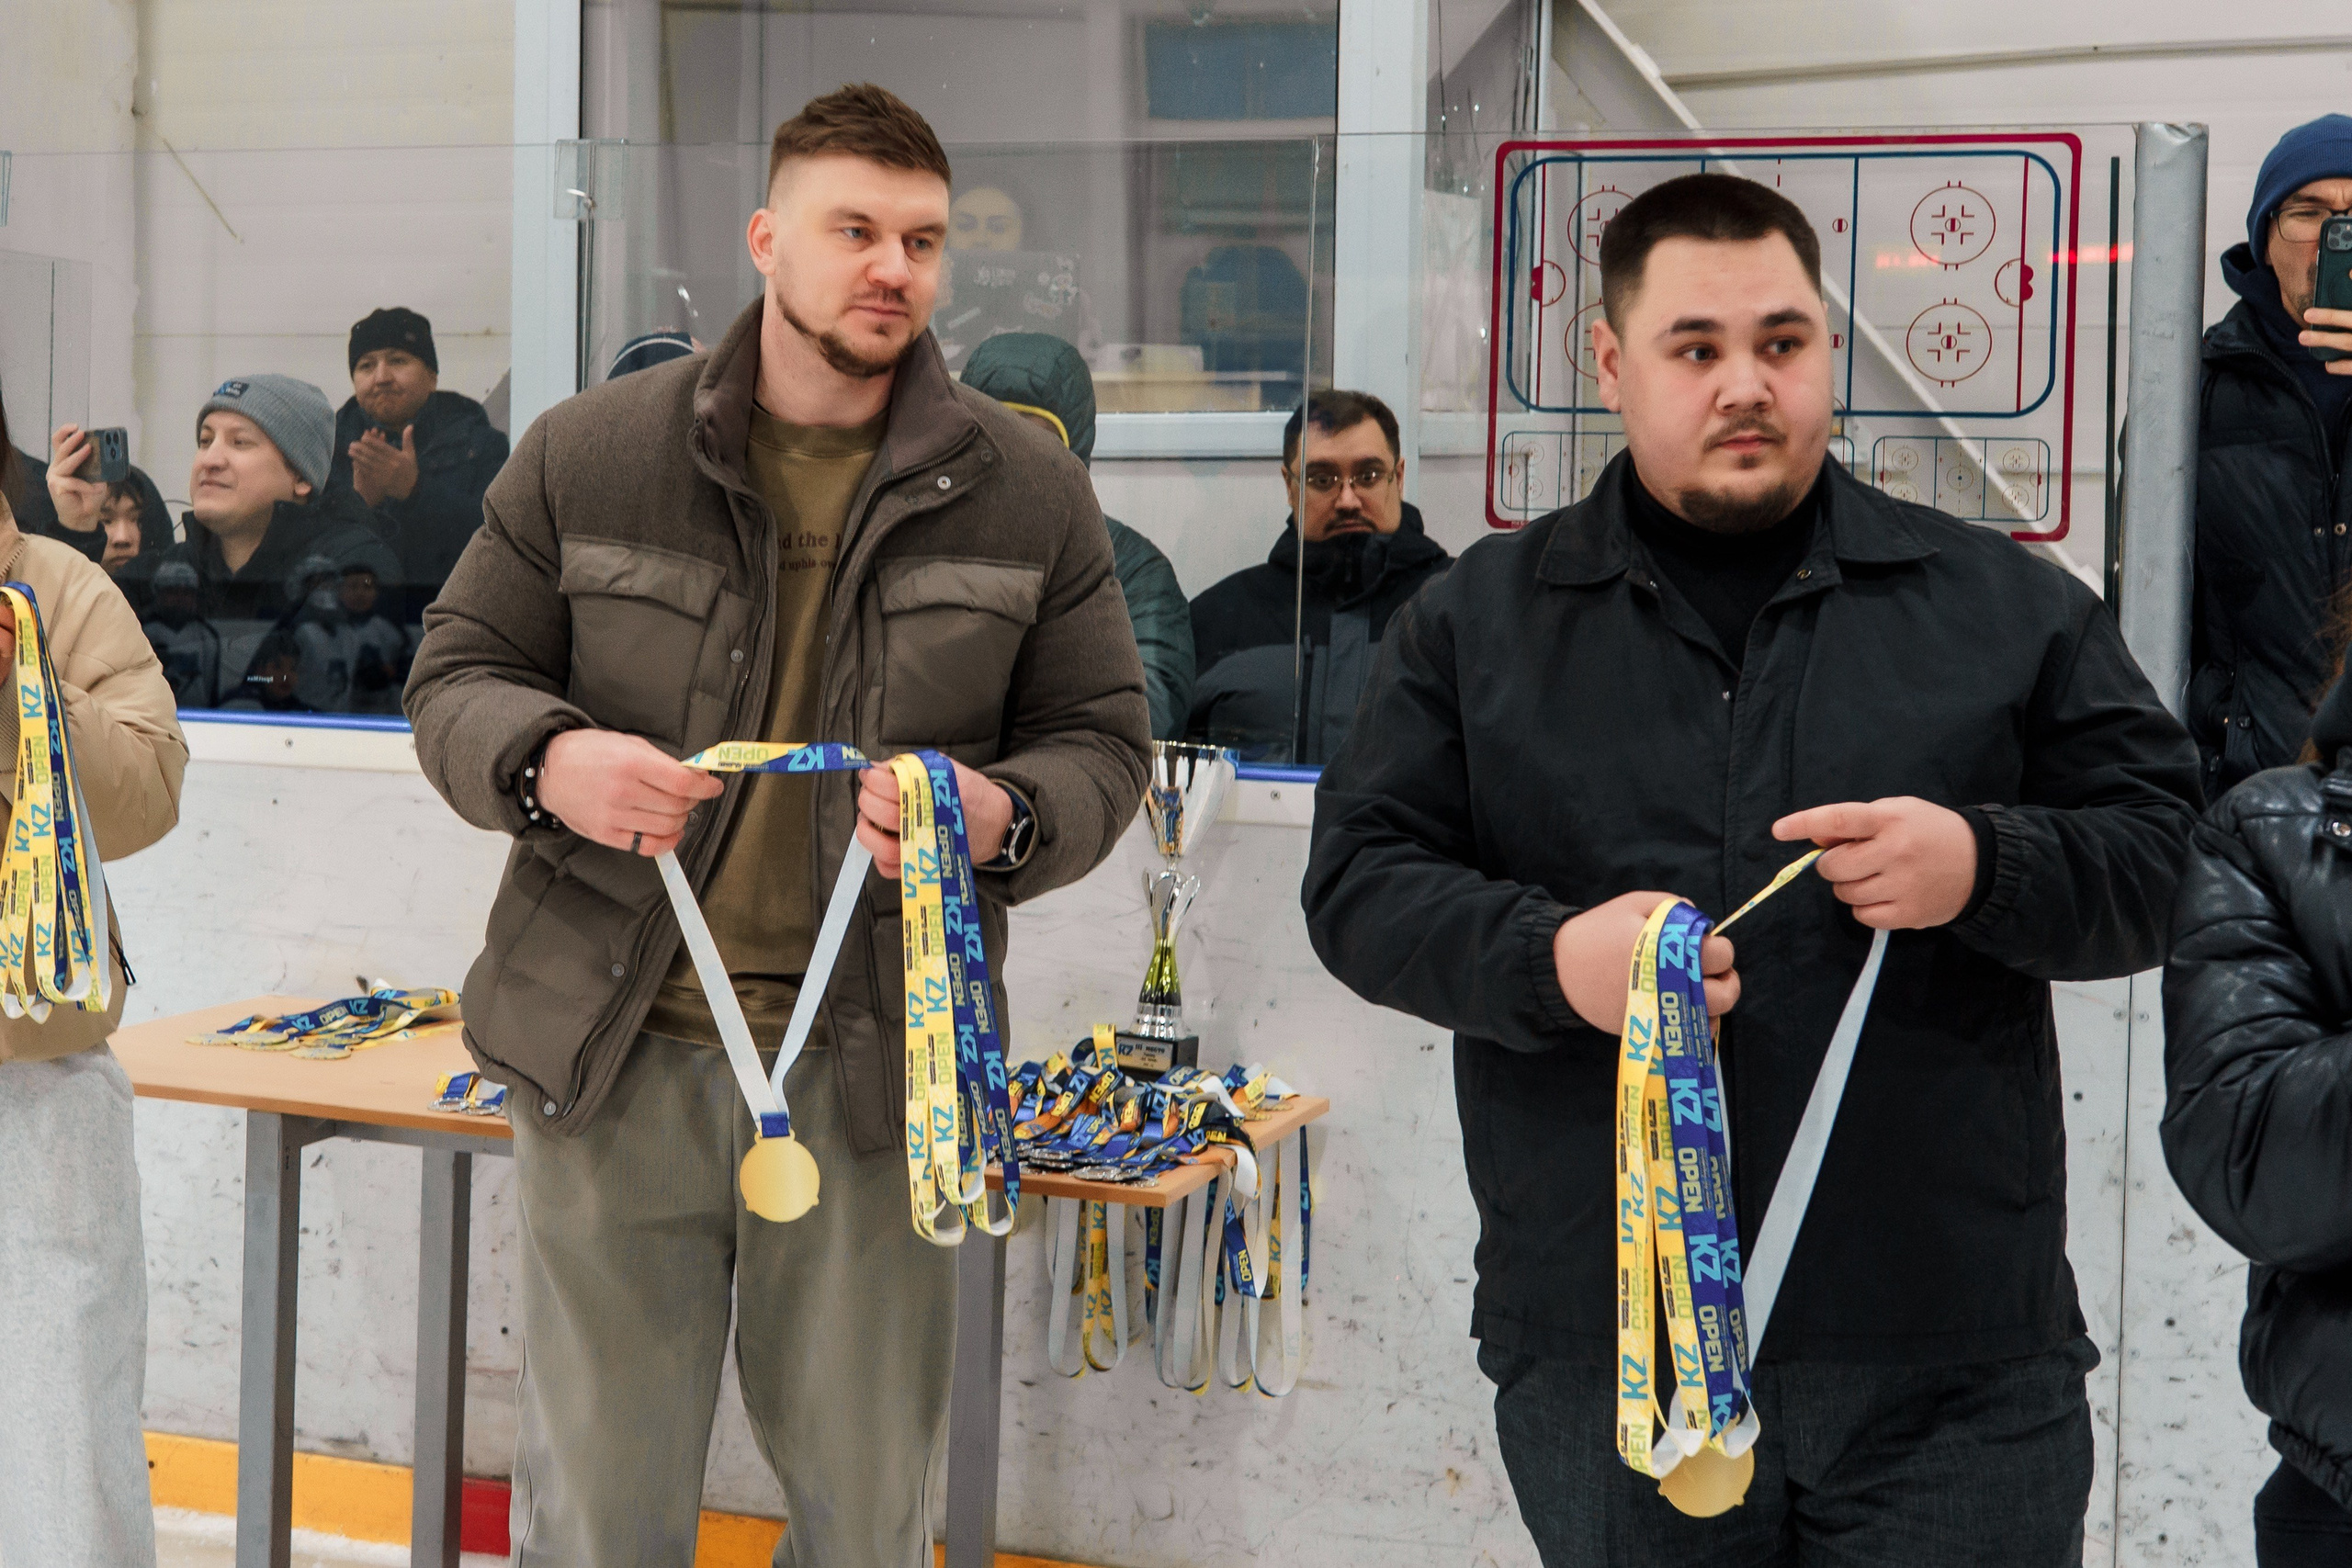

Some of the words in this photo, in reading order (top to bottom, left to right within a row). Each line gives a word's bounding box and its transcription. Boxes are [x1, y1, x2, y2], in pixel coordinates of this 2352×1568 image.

[798, 532, 828, 548] the
[22, 617, 37, 666] OPEN
[20, 683, 44, 718] KZ
[33, 736, 49, 784] OPEN
[49, 718, 62, 756] KZ
[718, 745, 769, 761] OPEN
[787, 745, 825, 772] KZ
[52, 772, 65, 821] OPEN
[930, 769, 952, 808] KZ
[31, 803, 51, 837] KZ
[58, 837, 76, 874] KZ
[918, 848, 940, 885] KZ
[937, 824, 953, 879] OPEN
[40, 854, 53, 905] OPEN
[10, 932, 24, 967] KZ
[17, 869, 30, 918] OPEN
[928, 904, 944, 956] OPEN
[944, 895, 963, 936] KZ
[36, 922, 51, 956] KZ
[963, 922, 984, 964] KZ
[1659, 923, 1689, 969] KZ
[925, 976, 948, 1012] KZ
[949, 953, 966, 1007] OPEN
[291, 1015, 315, 1032] KZ
[319, 1006, 349, 1026] OPEN
[349, 999, 369, 1015] KZ
[908, 992, 925, 1028] KZ
[969, 980, 990, 1034] OPEN
[1660, 990, 1685, 1056] OPEN
[935, 1032, 952, 1085] OPEN
[958, 1023, 979, 1065] KZ
[1118, 1043, 1134, 1056] KZ
[1626, 1015, 1652, 1062] KZ
[914, 1047, 928, 1100] OPEN
[983, 1050, 1007, 1091] KZ
[1089, 1070, 1115, 1104] OPEN
[932, 1104, 955, 1143] KZ
[1629, 1085, 1641, 1149] OPEN
[1669, 1078, 1703, 1126] KZ
[908, 1121, 925, 1159] KZ
[994, 1107, 1013, 1163] OPEN
[1631, 1171, 1645, 1218] KZ
[1678, 1146, 1703, 1213] OPEN
[1656, 1186, 1682, 1231] KZ
[1238, 1249, 1253, 1282] OPEN
[1689, 1233, 1722, 1283] KZ
[1719, 1238, 1742, 1289] KZ
[1672, 1255, 1694, 1319] OPEN
[1699, 1304, 1725, 1373] OPEN
[1729, 1308, 1747, 1374] OPEN
[1622, 1354, 1648, 1400] KZ
[1674, 1343, 1704, 1388] KZ
